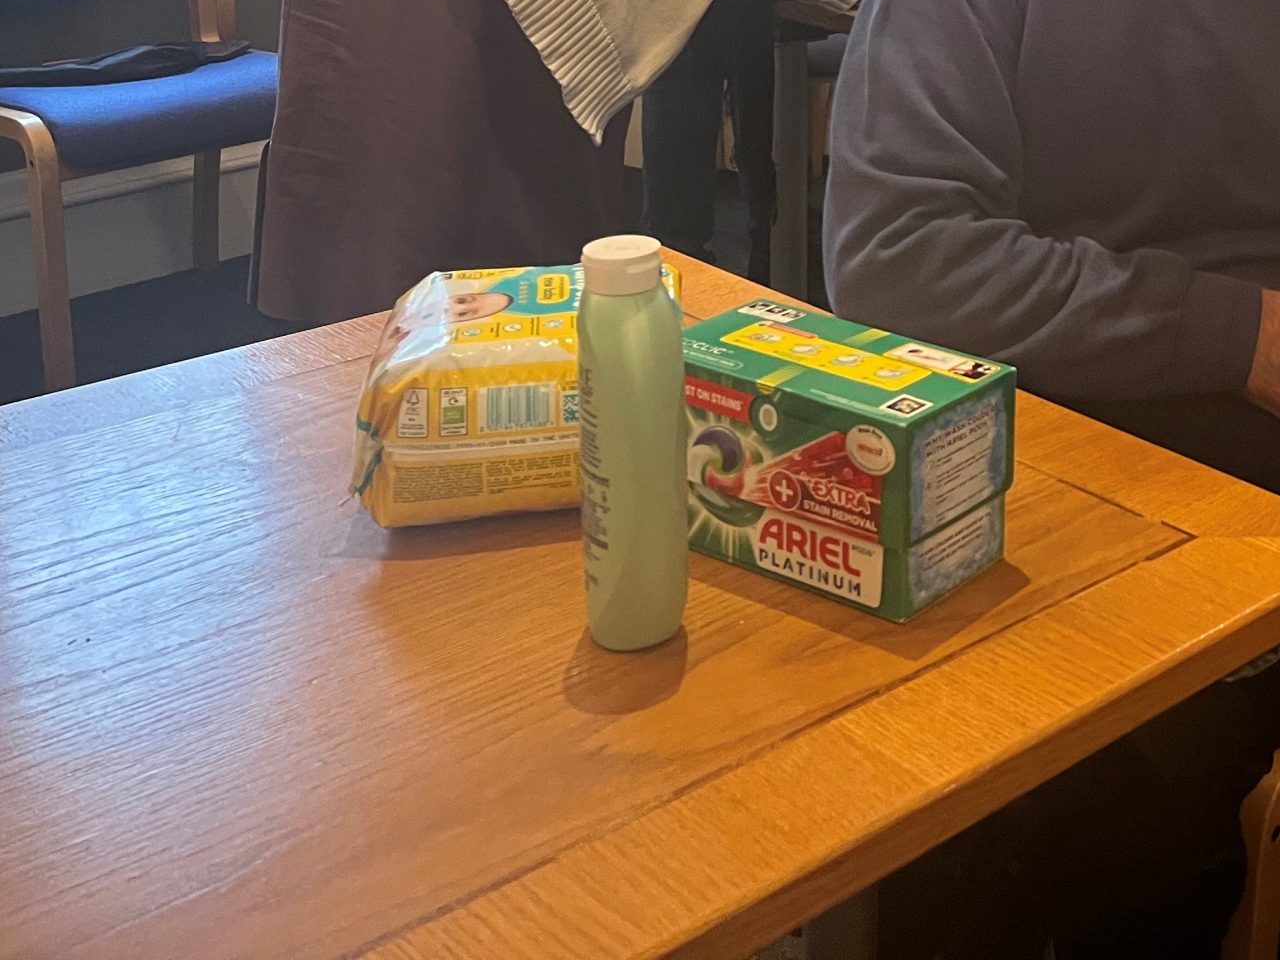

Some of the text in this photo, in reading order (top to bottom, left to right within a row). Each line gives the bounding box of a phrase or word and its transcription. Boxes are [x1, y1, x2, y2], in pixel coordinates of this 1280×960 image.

[803, 499, 878, 533] STAIN REMOVAL
[809, 477, 870, 515] EXTRA
[758, 518, 862, 578] ARIEL
[758, 547, 863, 597] PLATINUM
